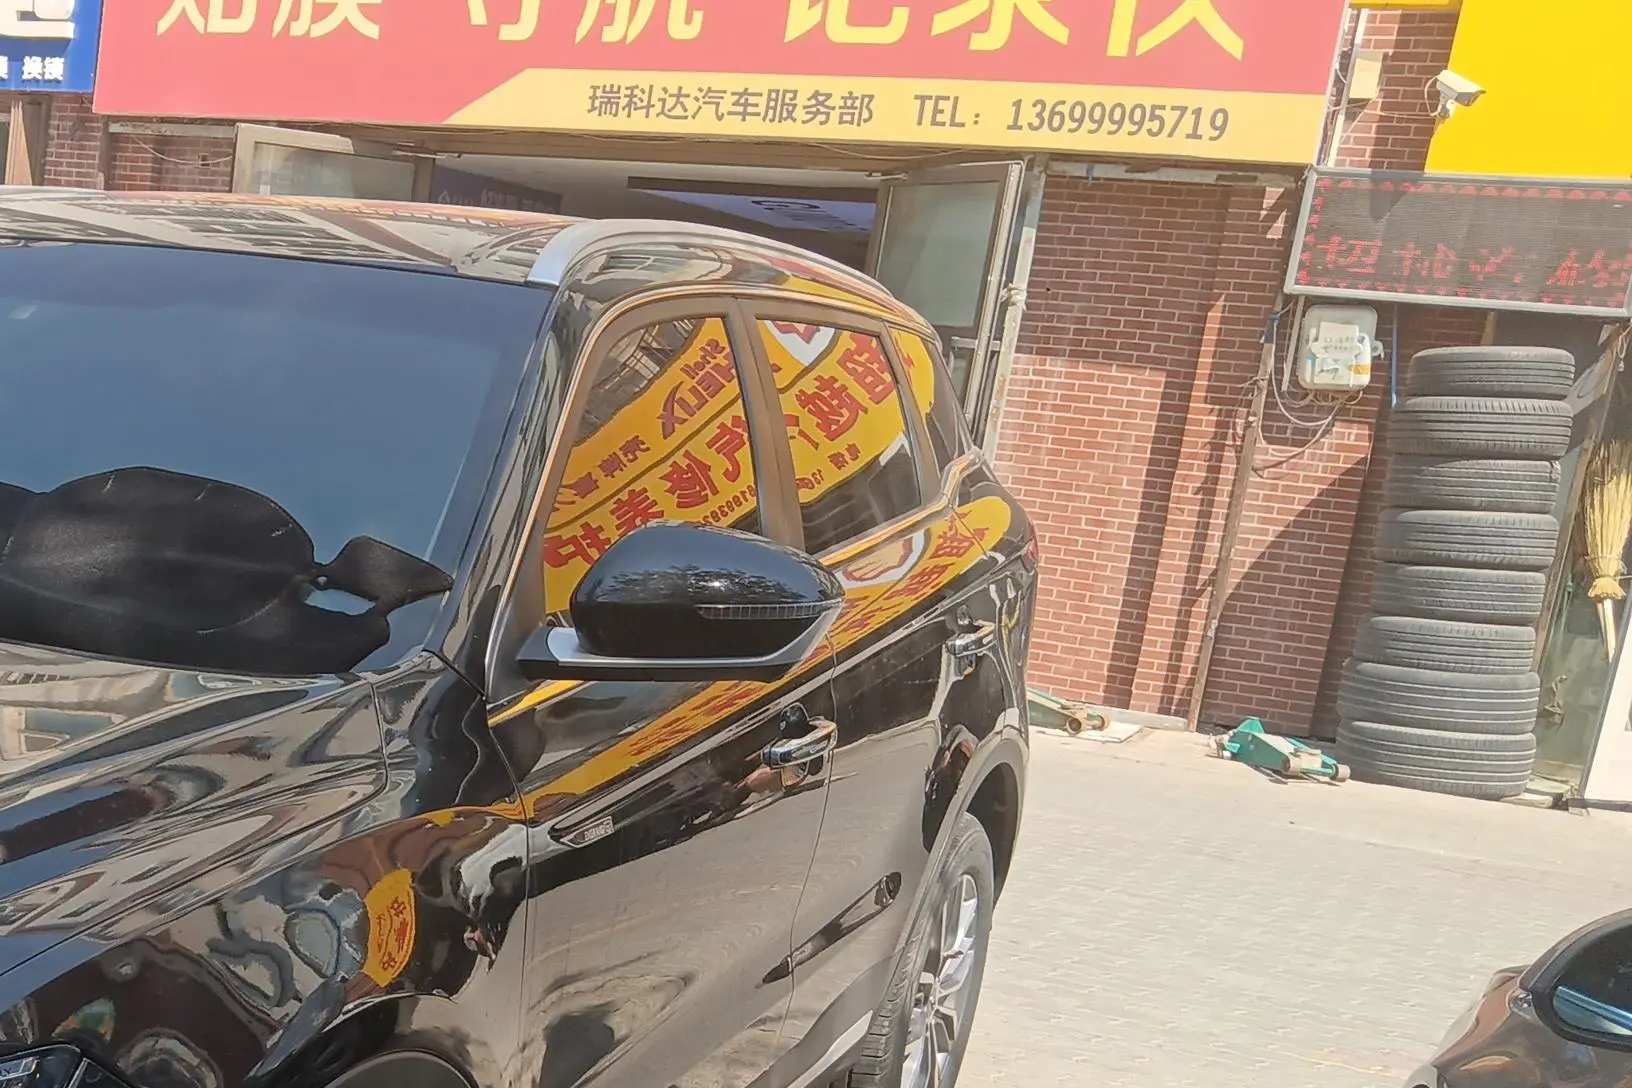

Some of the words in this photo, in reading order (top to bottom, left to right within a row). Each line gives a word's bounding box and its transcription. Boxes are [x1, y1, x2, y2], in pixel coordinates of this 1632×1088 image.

[586, 83, 876, 127] 瑞科达汽车服务部
[1006, 98, 1230, 141] 13699995719
